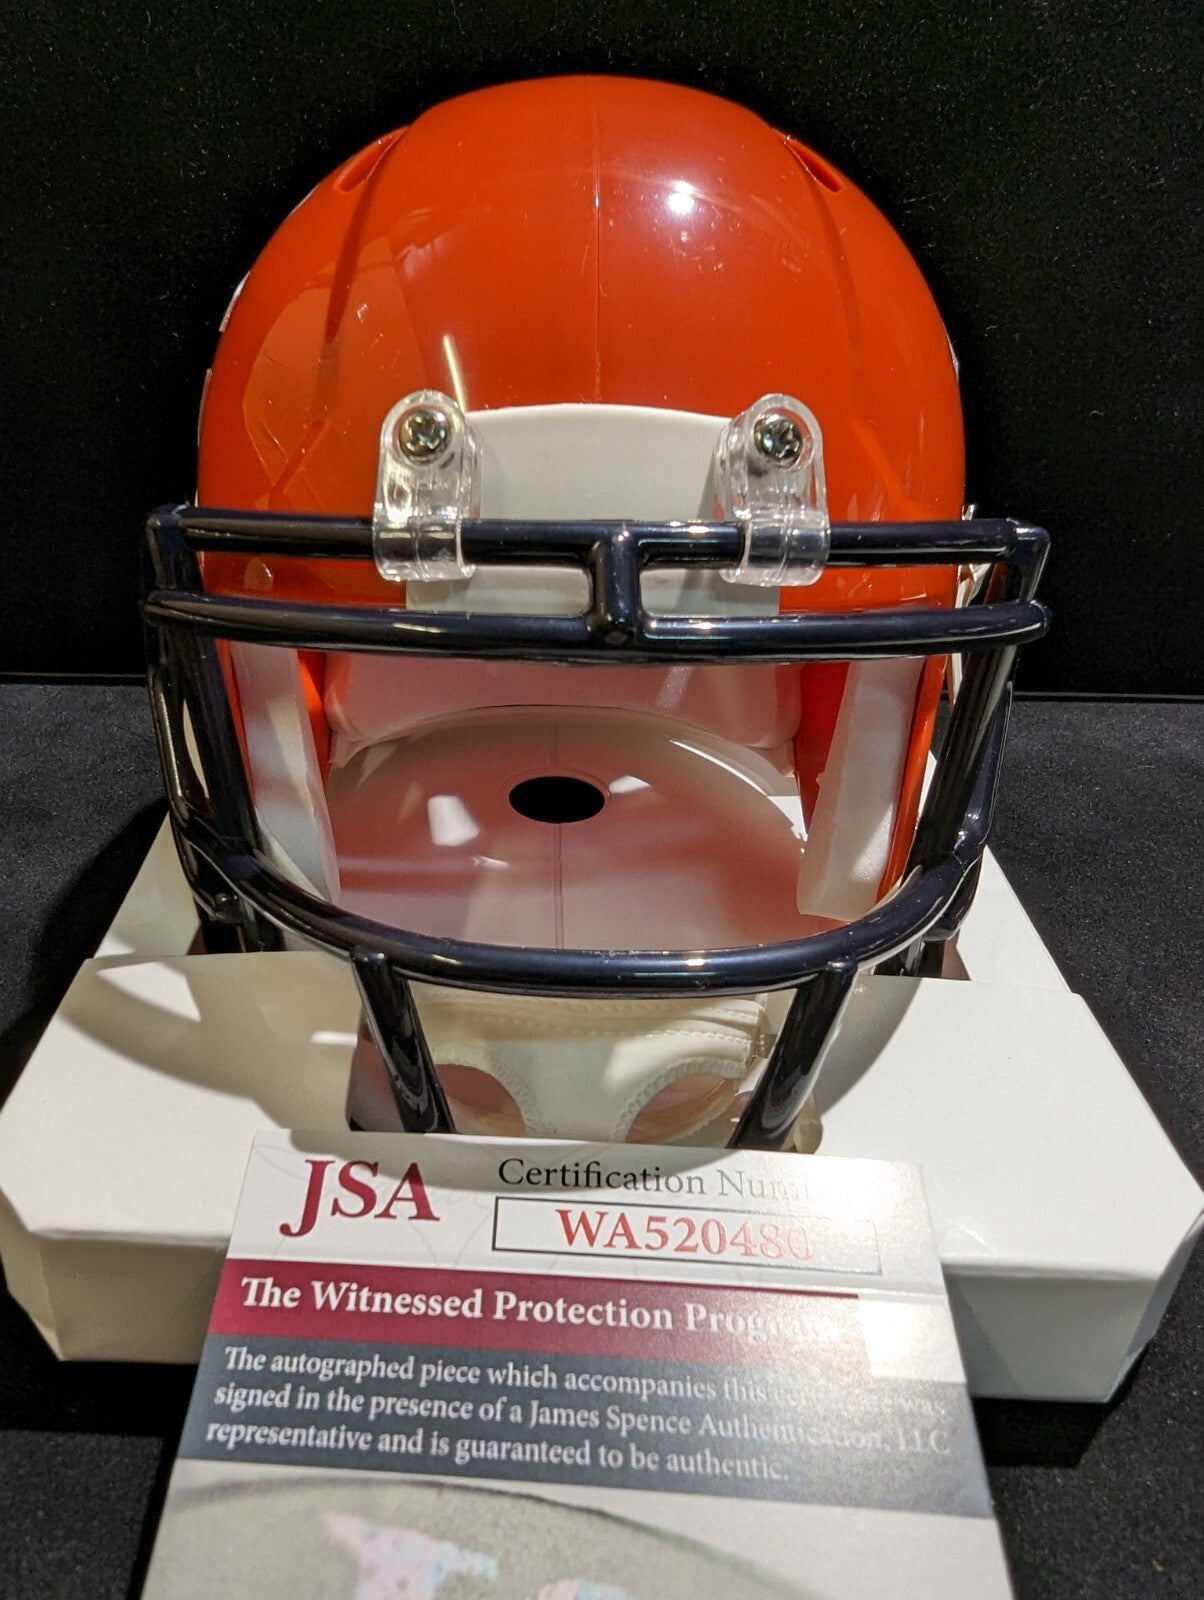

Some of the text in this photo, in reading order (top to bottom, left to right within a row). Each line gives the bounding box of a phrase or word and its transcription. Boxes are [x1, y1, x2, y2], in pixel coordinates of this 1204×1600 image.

[279, 1159, 440, 1237] JSA
[498, 1157, 811, 1201] Certification Num
[555, 1209, 817, 1261] WA520480
[240, 1276, 301, 1309] The
[310, 1280, 483, 1319] Witnessed
[493, 1290, 673, 1330] Protection
[224, 1346, 267, 1370] The
[270, 1353, 415, 1384] autographed
[419, 1360, 481, 1388] piece
[487, 1362, 558, 1390] which
[564, 1374, 716, 1402] accompanies
[723, 1377, 768, 1402] this
[213, 1382, 292, 1413] signed
[296, 1385, 320, 1410] in
[326, 1387, 365, 1412] the
[368, 1394, 474, 1421] presence
[478, 1396, 508, 1422] of
[509, 1405, 523, 1422] a
[528, 1400, 600, 1429] James
[606, 1405, 692, 1438] Spence
[205, 1422, 790, 1481] representative and is guaranteed to be authentic.
